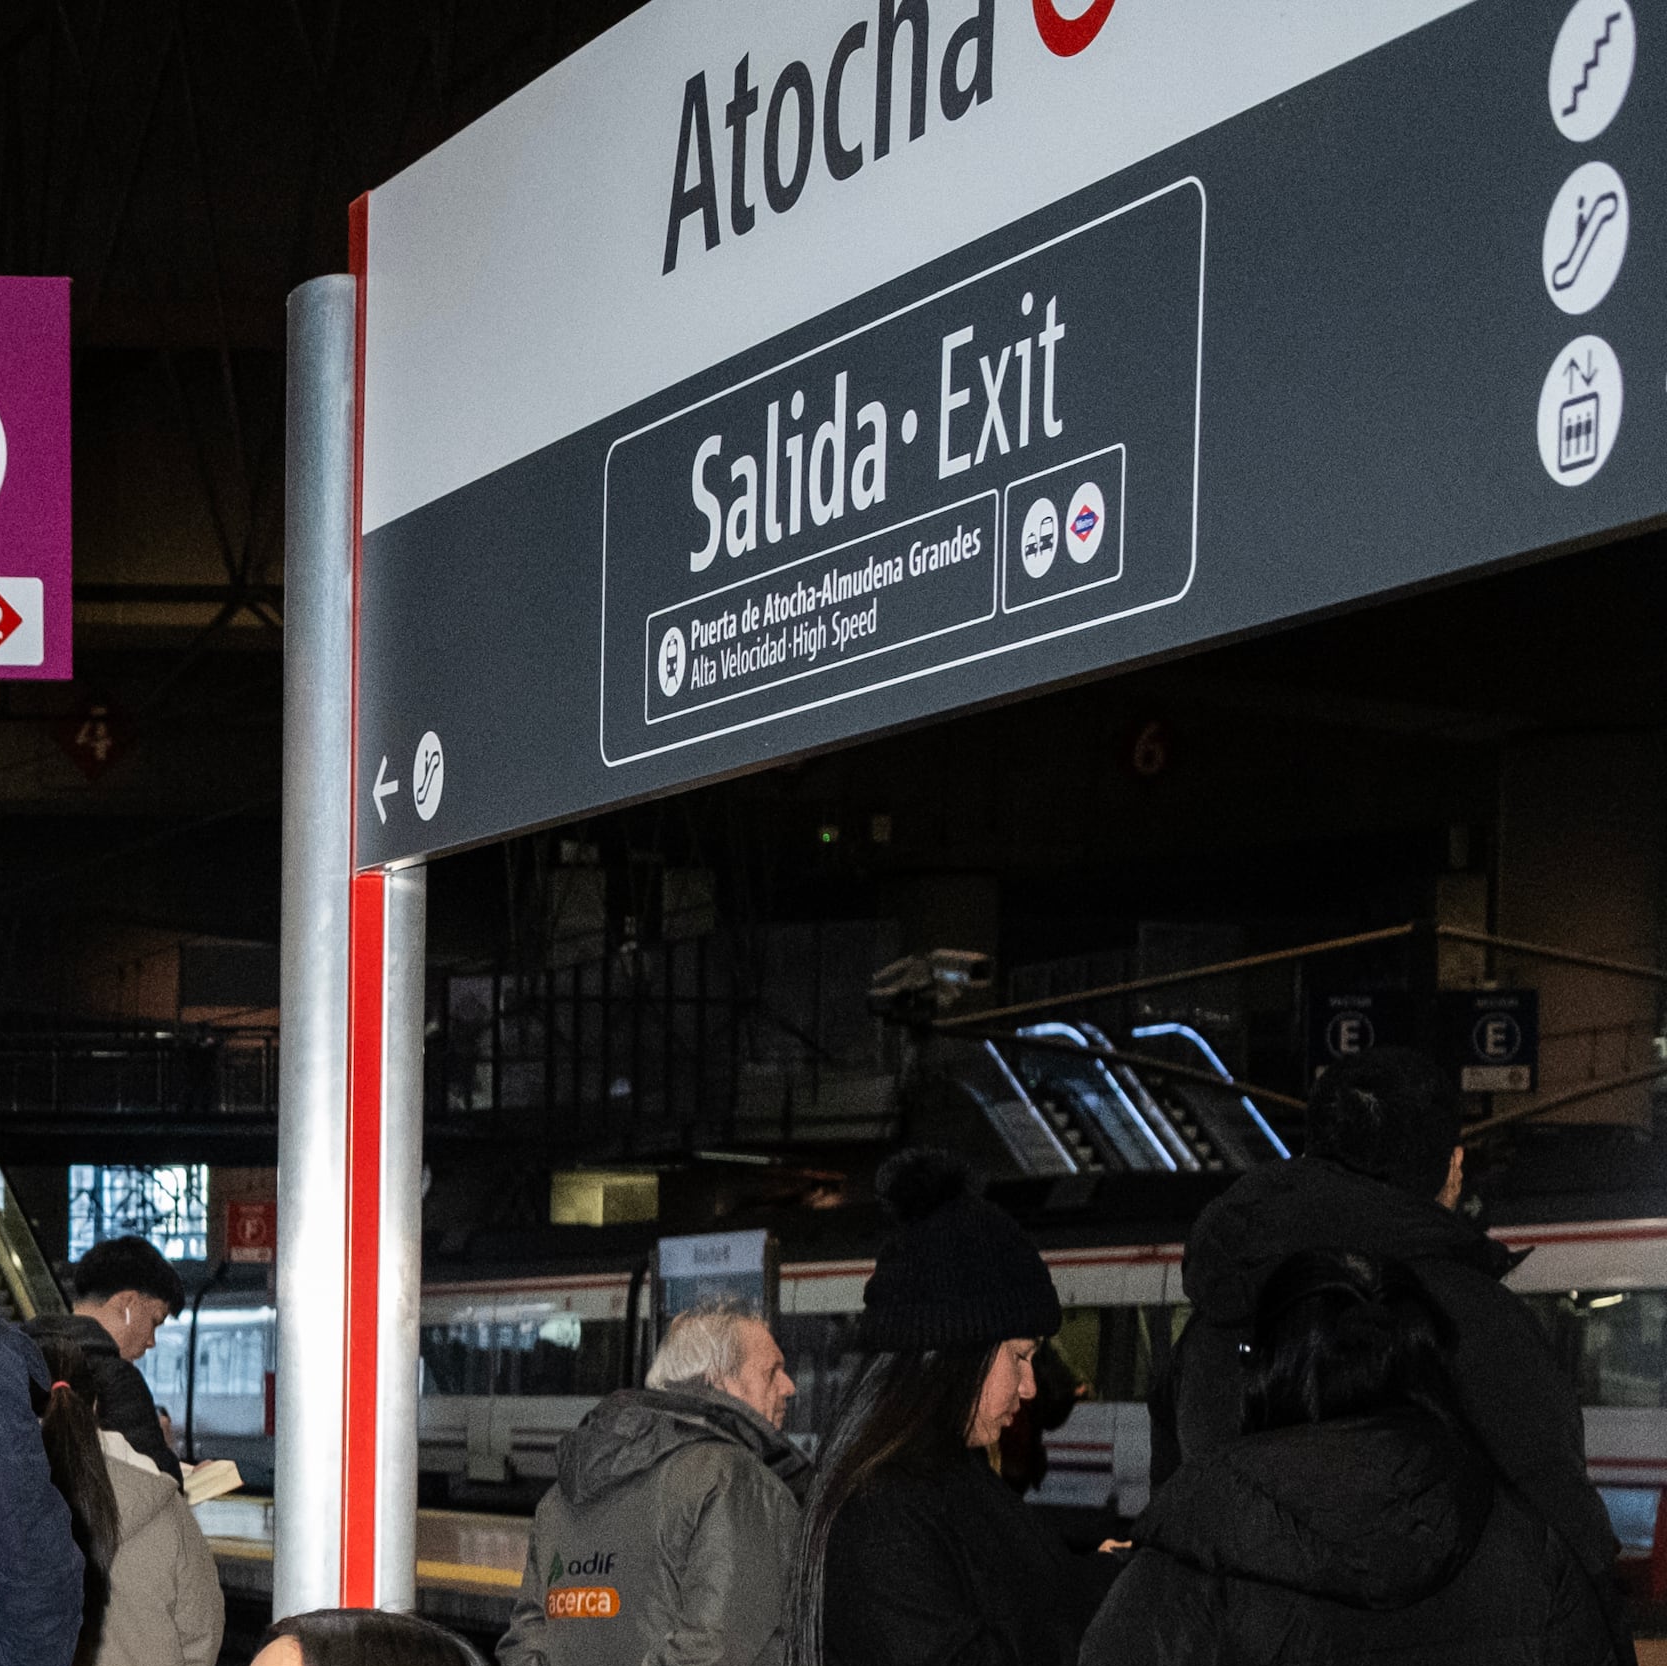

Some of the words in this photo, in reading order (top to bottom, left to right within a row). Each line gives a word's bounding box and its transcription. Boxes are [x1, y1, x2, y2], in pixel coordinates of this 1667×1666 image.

[662, 0, 995, 276] Atocha
[689, 372, 887, 573] Salida
[938, 292, 1066, 481] Exit
[691, 610, 737, 651] Puerta
[741, 599, 760, 633] de
[763, 555, 903, 628] Atocha-Almudena
[908, 524, 982, 578] Grandes
[691, 657, 717, 690] Alta
[831, 597, 878, 652] Speed
[74, 705, 113, 761] 4
[1132, 719, 1165, 776] 6
[1339, 1020, 1361, 1053] E
[1486, 1022, 1507, 1055] E
[568, 1551, 618, 1576] adif
[548, 1591, 611, 1615] acerca
